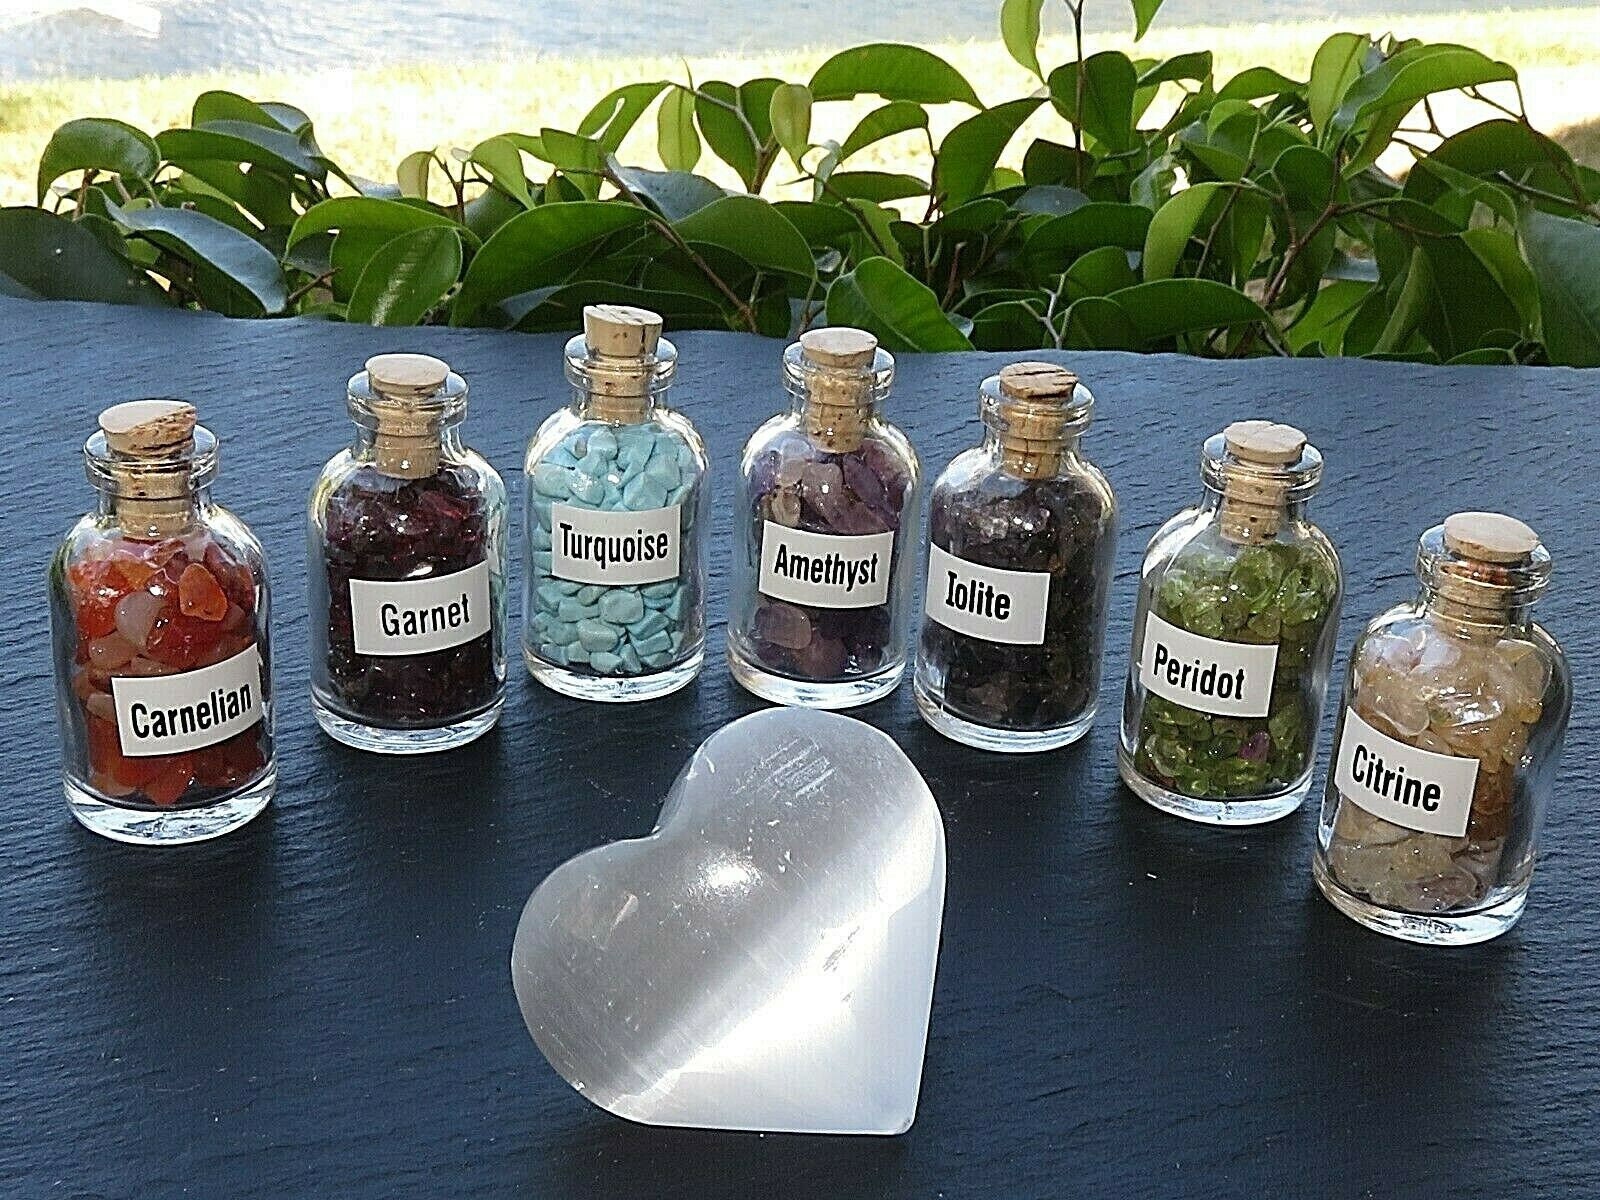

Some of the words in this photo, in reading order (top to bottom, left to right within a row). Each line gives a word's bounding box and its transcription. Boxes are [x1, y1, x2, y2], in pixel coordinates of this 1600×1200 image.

[559, 522, 668, 570] Turquoise
[773, 543, 879, 593] Amethyst
[381, 593, 470, 637] Garnet
[945, 570, 1011, 621] Iolite
[1153, 642, 1245, 701] Peridot
[130, 683, 252, 739] Carnelian
[1352, 744, 1441, 812] Citrine
